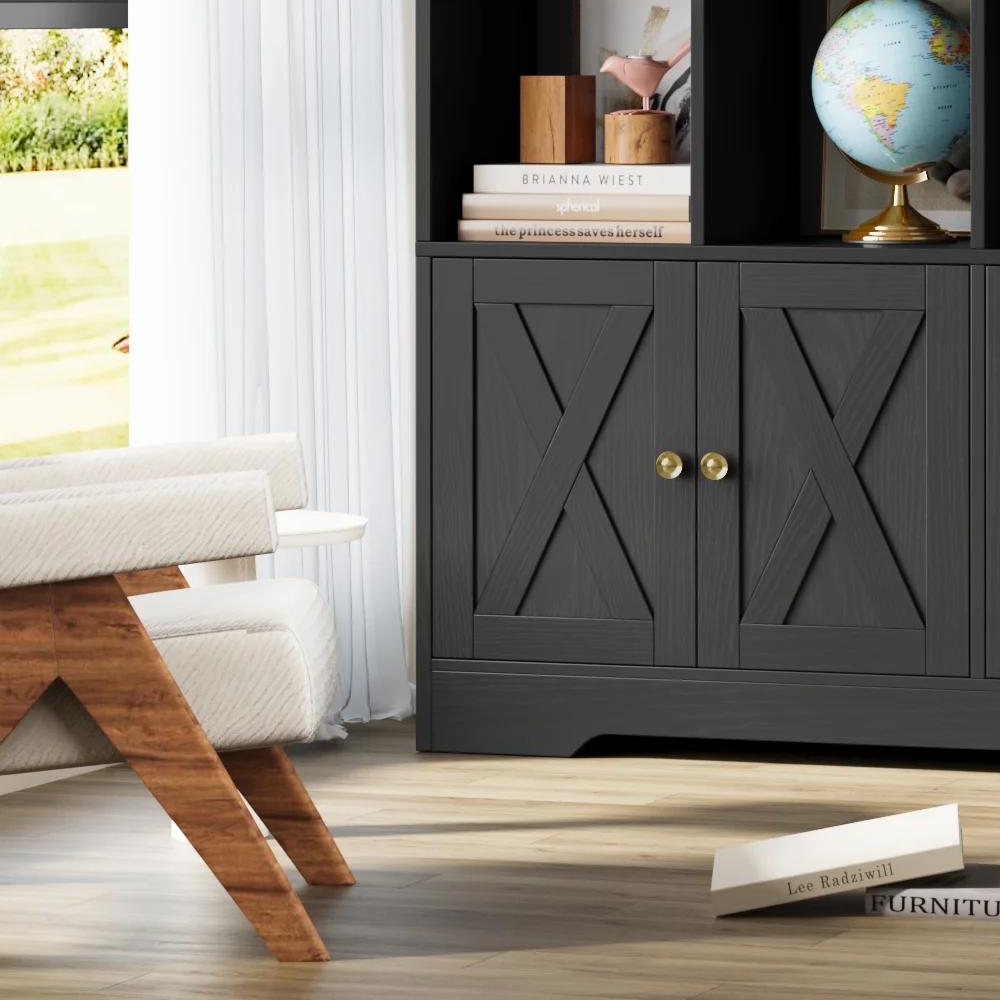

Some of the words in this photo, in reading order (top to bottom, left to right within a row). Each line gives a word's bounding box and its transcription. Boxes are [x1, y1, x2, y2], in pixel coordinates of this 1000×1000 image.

[522, 174, 591, 186] BRIANNA
[599, 175, 644, 186] WIEST
[786, 878, 814, 896] Lee
[817, 863, 895, 890] Radziwill
